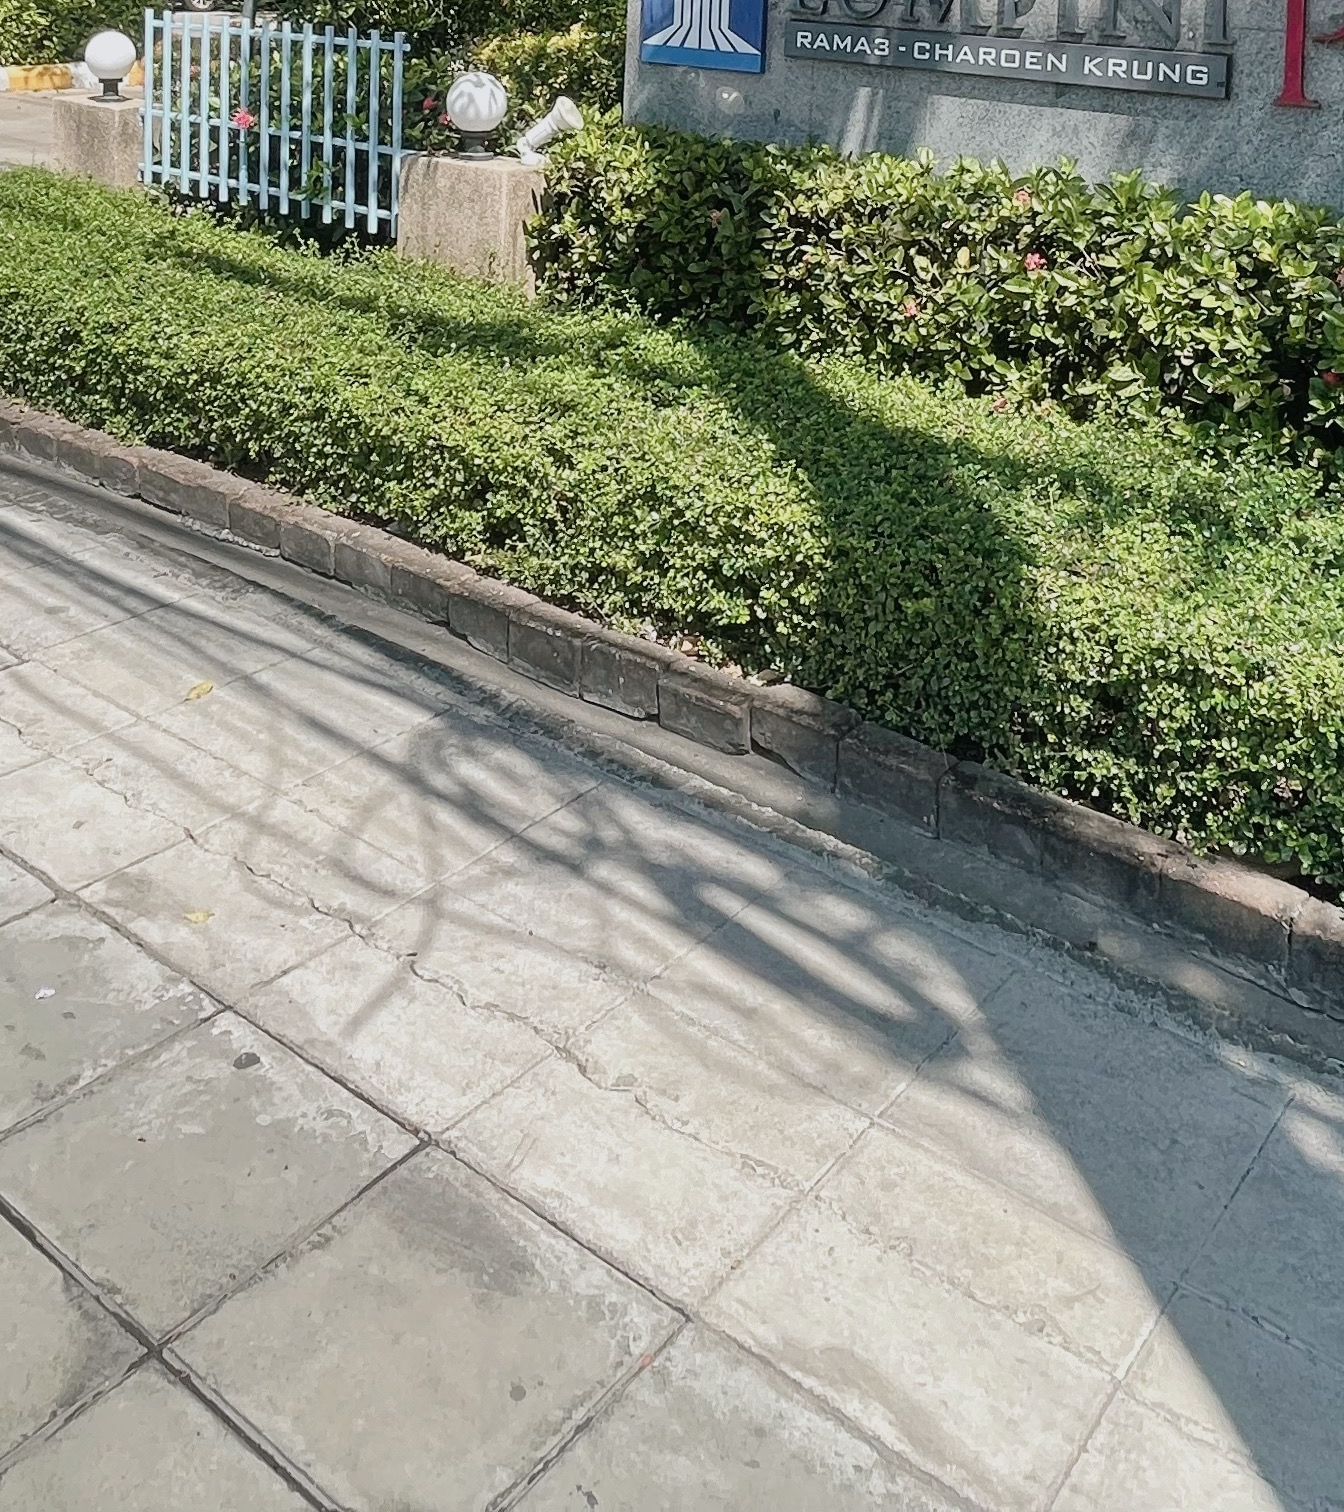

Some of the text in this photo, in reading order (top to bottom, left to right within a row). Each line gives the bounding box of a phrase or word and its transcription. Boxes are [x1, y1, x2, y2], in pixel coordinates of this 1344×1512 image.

[795, 30, 891, 57] RAMA3
[912, 40, 1068, 73] CHAROEN
[1082, 54, 1210, 86] KRUNG
